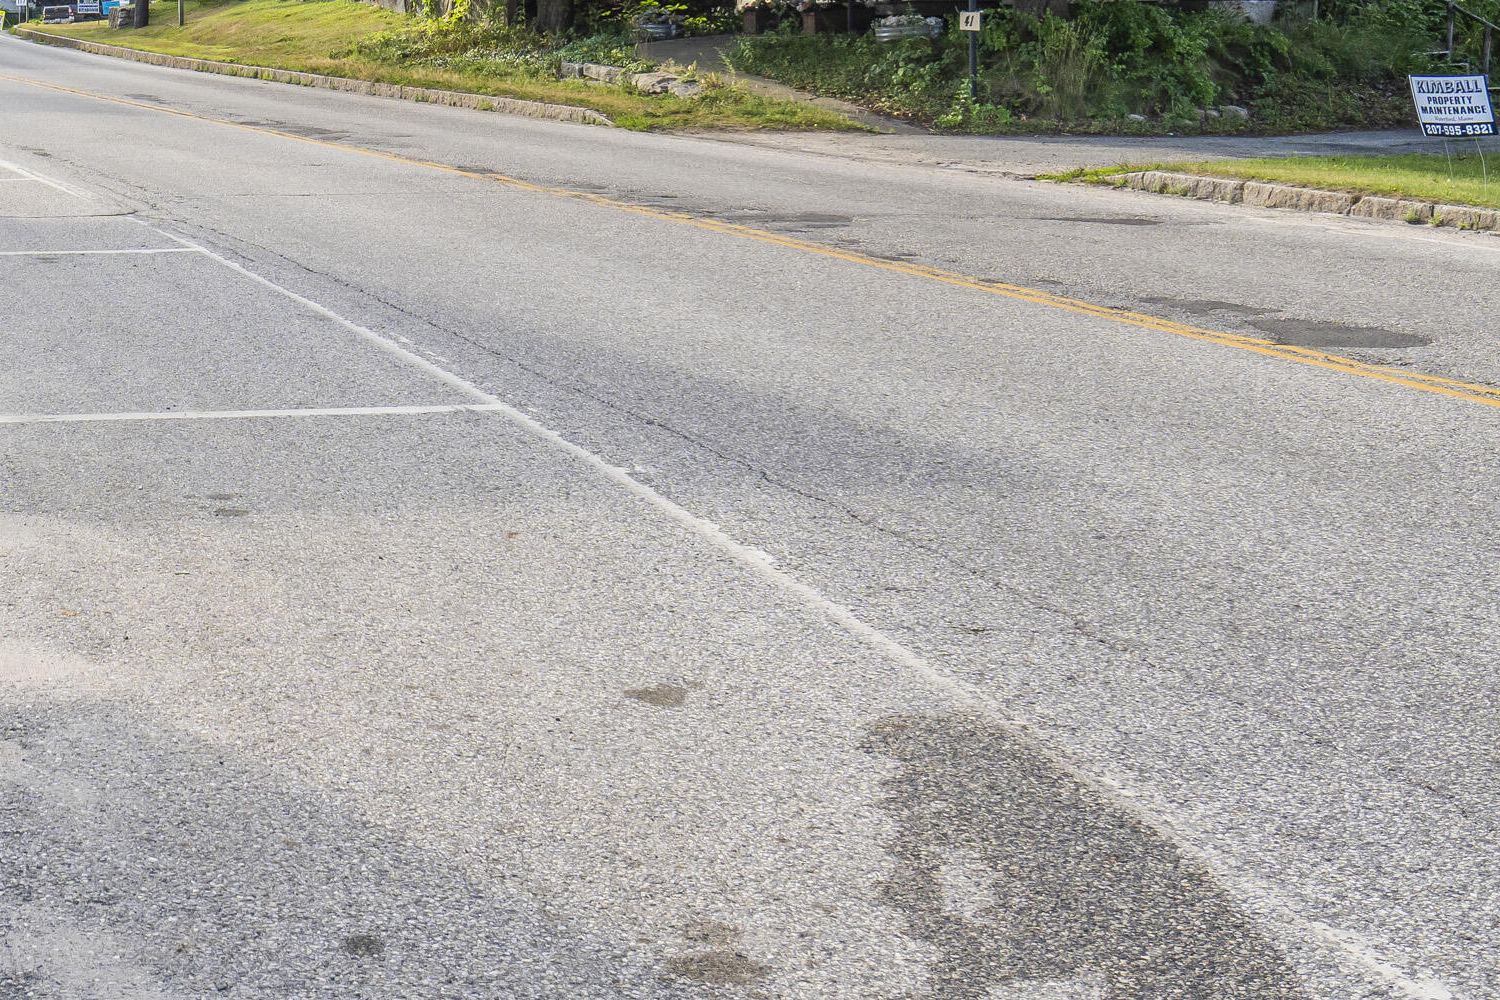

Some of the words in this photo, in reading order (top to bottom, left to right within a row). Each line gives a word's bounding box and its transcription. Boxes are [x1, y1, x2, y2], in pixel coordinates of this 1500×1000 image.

[963, 15, 975, 27] 41
[1415, 79, 1483, 94] KIMBALL
[1426, 96, 1472, 105] PROPERTY
[1420, 105, 1488, 115] MAINTENANCE
[1425, 123, 1493, 135] 207-595-8321
